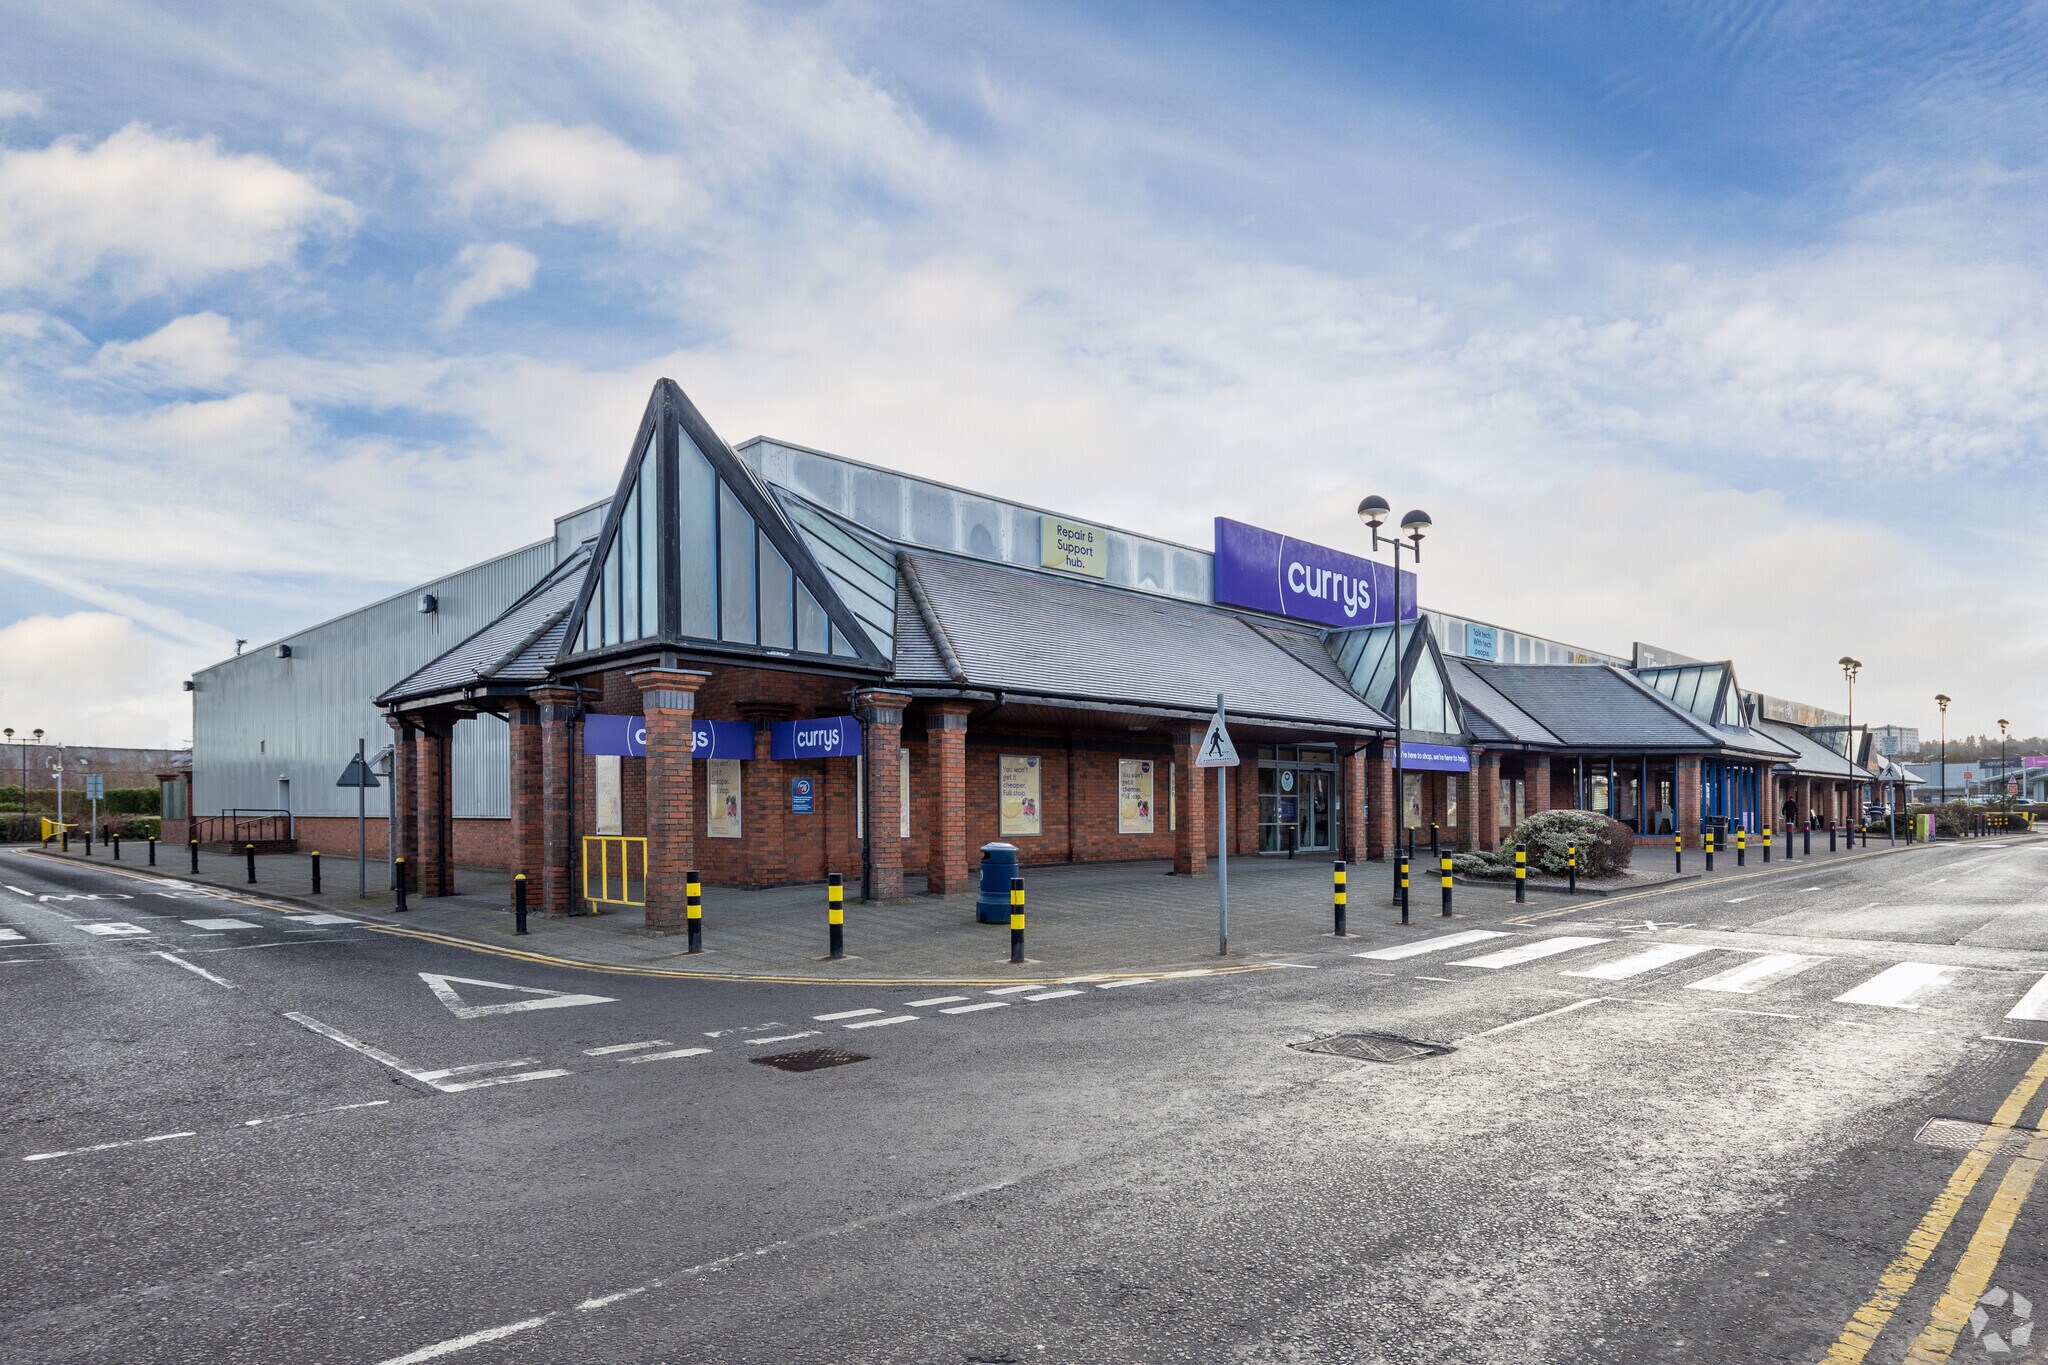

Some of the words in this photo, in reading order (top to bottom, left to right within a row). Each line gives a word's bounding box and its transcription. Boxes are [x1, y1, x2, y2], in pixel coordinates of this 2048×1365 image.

[1056, 524, 1086, 541] Repair
[1087, 532, 1094, 543] &
[1057, 539, 1093, 557] Support
[1066, 555, 1085, 569] hub.
[1287, 561, 1371, 618] currys
[1473, 628, 1481, 637] Talk
[1473, 638, 1483, 647] With
[1483, 640, 1492, 649] tech
[1474, 648, 1490, 658] people.
[797, 728, 840, 752] currys
[1408, 751, 1417, 759] here
[1417, 752, 1422, 760] to
[1433, 753, 1444, 761] we're
[1444, 754, 1453, 762] here
[1003, 774, 1012, 782] get
